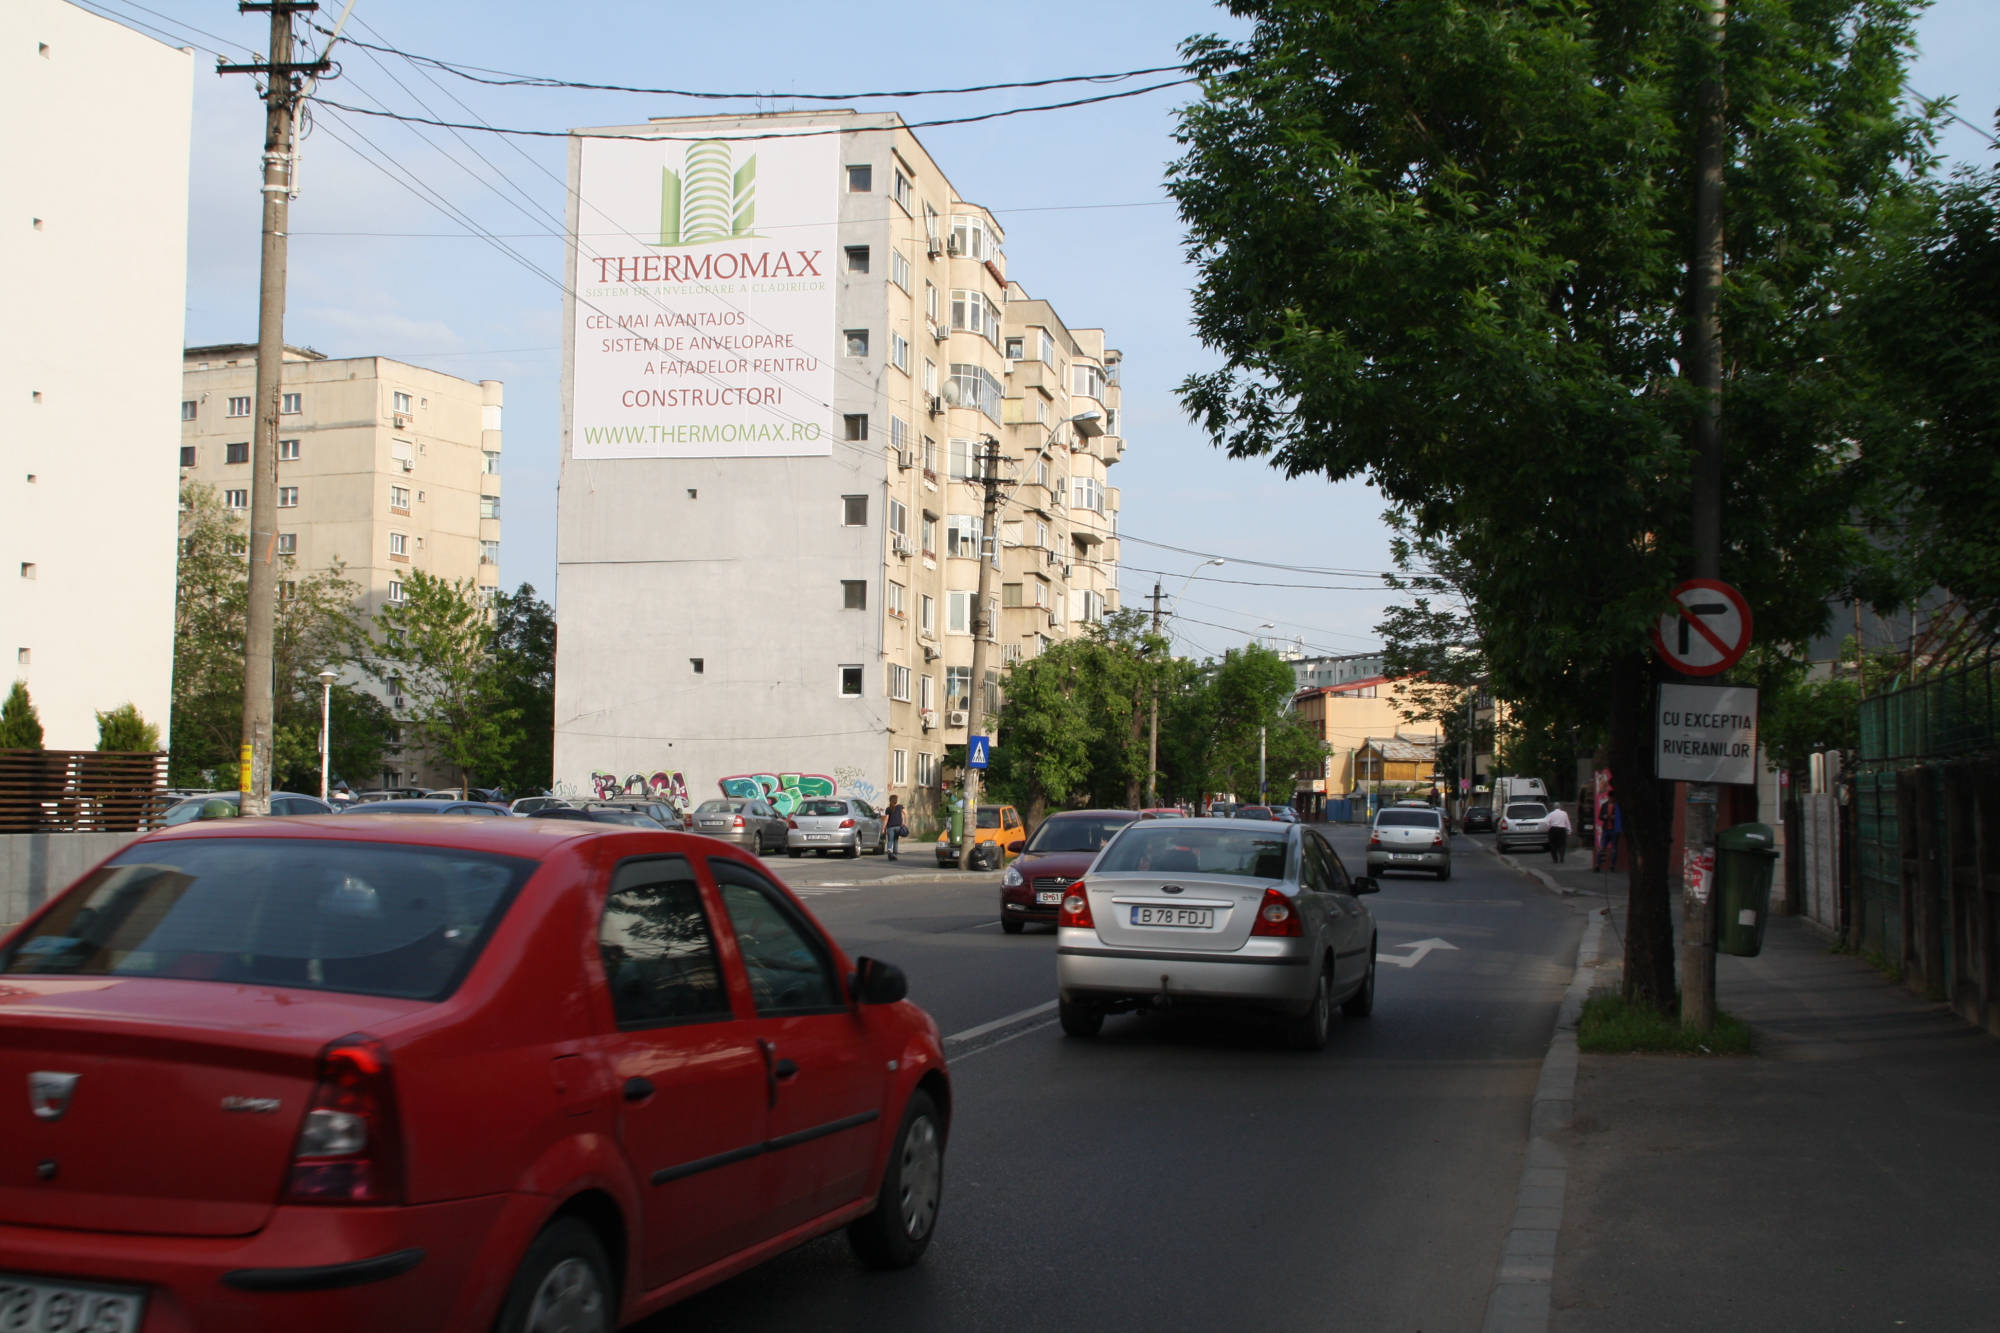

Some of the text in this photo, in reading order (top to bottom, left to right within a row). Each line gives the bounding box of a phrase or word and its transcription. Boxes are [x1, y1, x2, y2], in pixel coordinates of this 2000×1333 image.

[592, 250, 823, 284] THERMOMAX
[585, 281, 826, 298] SISTEM DE ANVELOPARE A CLADIRILOR
[586, 311, 745, 330] CEL MAI AVANTAJOS
[602, 334, 794, 353] SISTEM DE ANVELOPARE
[644, 361, 655, 375] A
[754, 357, 818, 373] PENTRU
[622, 387, 782, 408] CONSTRUCTORI
[584, 422, 822, 444] WWW.THERMOMAX.RO
[1663, 711, 1752, 729] CU EXCEPTIA
[1663, 739, 1751, 758] RIVERANILOR
[1142, 909, 1207, 926] B 78 FDJ
